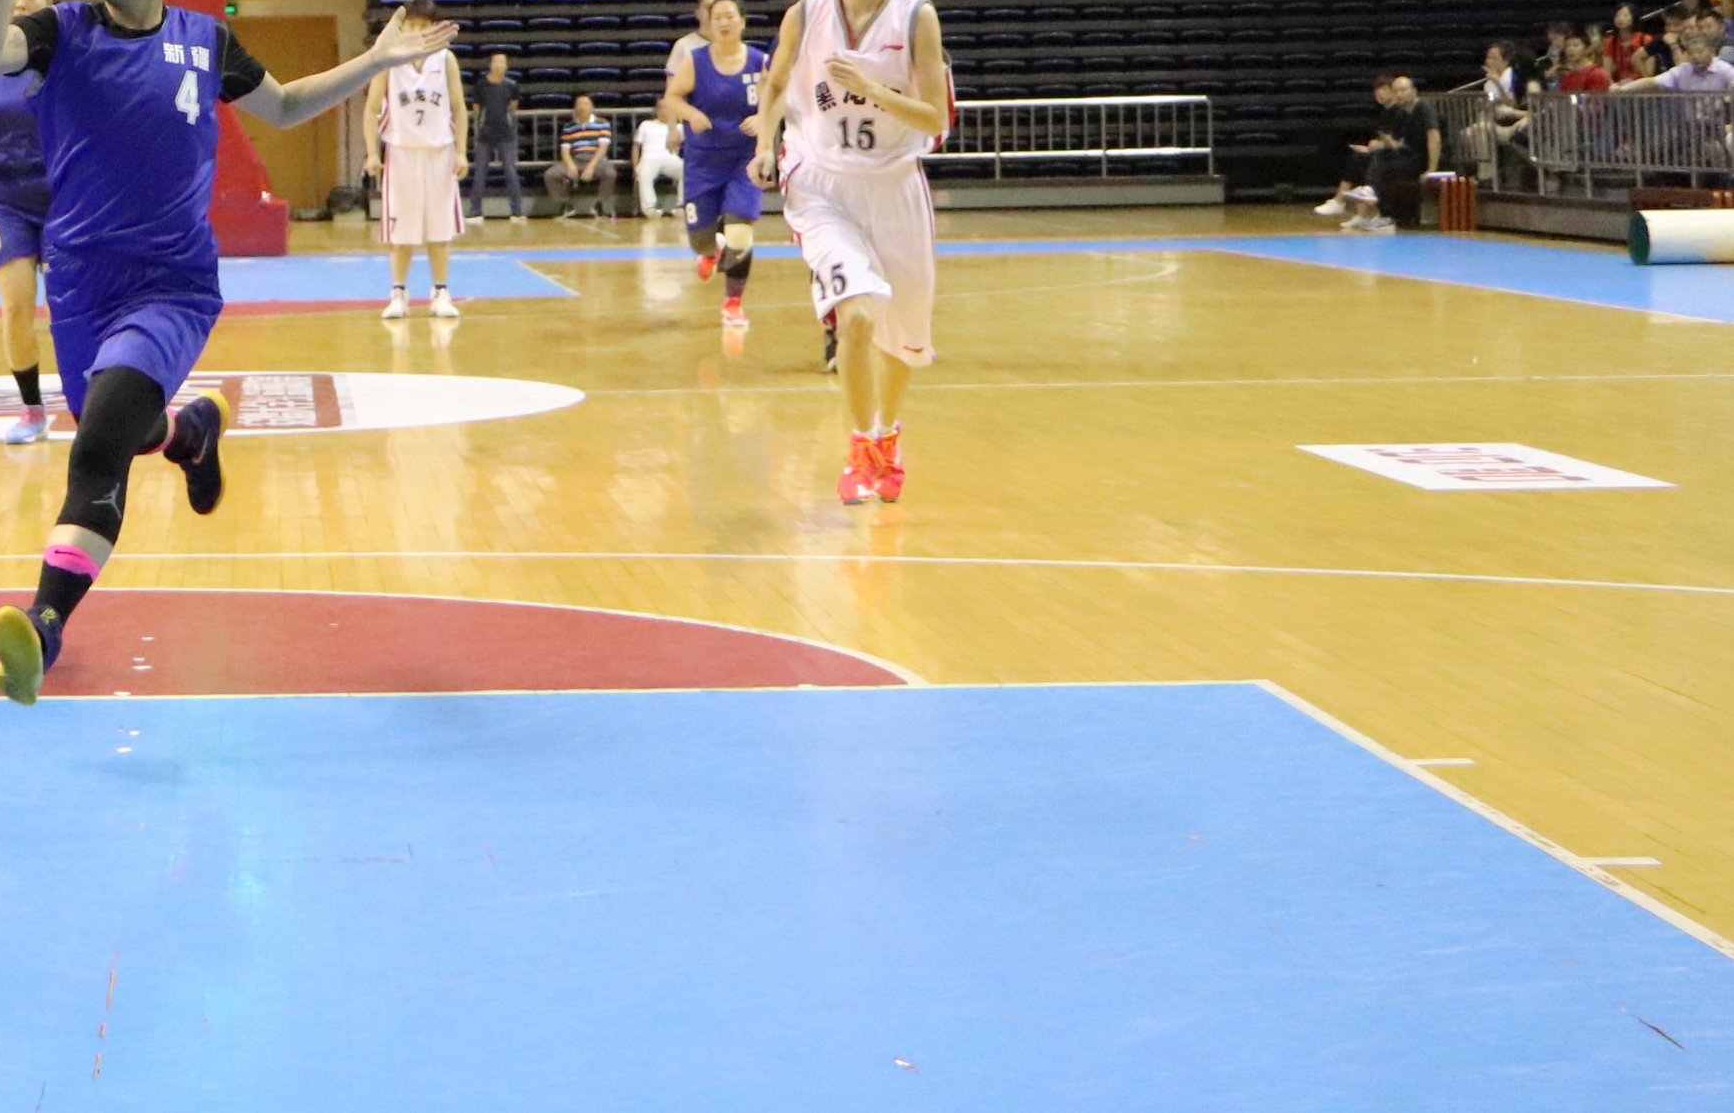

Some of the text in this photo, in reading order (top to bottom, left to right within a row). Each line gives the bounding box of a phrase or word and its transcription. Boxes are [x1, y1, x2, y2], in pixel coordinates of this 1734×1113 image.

[174, 70, 200, 125] 4
[414, 109, 425, 126] 7
[839, 117, 876, 151] 15
[684, 202, 698, 224] 8
[814, 261, 847, 301] 15
